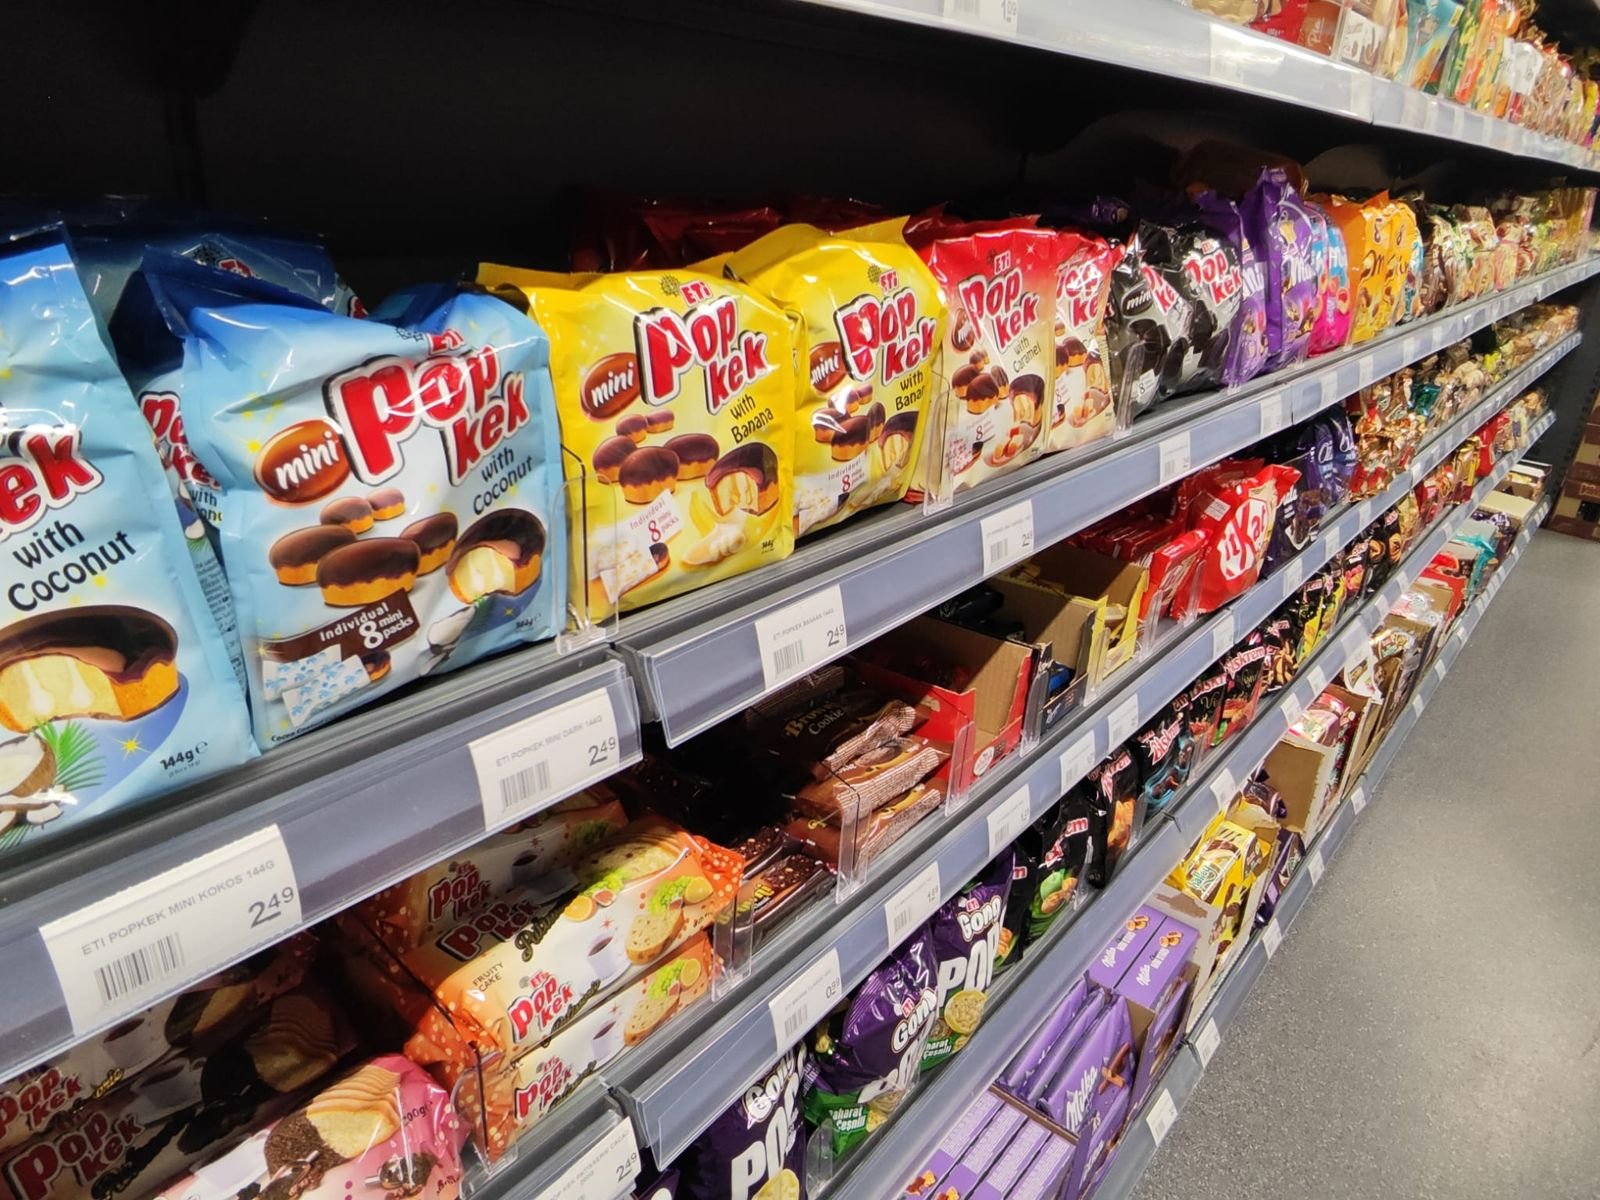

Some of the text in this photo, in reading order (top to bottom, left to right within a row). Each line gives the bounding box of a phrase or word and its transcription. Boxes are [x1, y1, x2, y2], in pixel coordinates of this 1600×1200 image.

[681, 281, 711, 304] ETi
[810, 349, 840, 385] mini
[883, 320, 935, 383] kek
[1013, 342, 1041, 374] Caramel
[590, 361, 635, 409] mini
[706, 335, 767, 411] kek
[900, 371, 924, 393] with
[333, 344, 499, 480] Pop
[729, 393, 757, 421] with
[450, 378, 530, 480] kek
[730, 407, 775, 445] Banana
[974, 424, 984, 442] 8
[275, 430, 341, 491] mini
[480, 447, 515, 483] with
[0, 430, 100, 530] ek
[473, 454, 534, 517] Coconut
[842, 473, 851, 492] 8
[11, 520, 86, 571] with
[648, 519, 661, 543] 8
[6, 528, 137, 613] Coconut
[319, 600, 390, 643] Individual
[358, 620, 384, 649] 8
[378, 609, 404, 628] mini
[382, 616, 415, 640] packs
[826, 624, 845, 648] 249
[159, 749, 194, 771] 144g
[587, 736, 618, 767] 249
[81, 859, 276, 957] ETI POPKEK MINI KOKOS 144G
[247, 885, 295, 930] 249
[471, 961, 505, 989] FRUITY
[477, 972, 503, 995] CAKE
[509, 976, 558, 1041] Pop
[539, 983, 574, 1029] kek
[30, 1076, 82, 1128] kek
[78, 1116, 145, 1183] kek
[615, 1151, 638, 1184] 249
